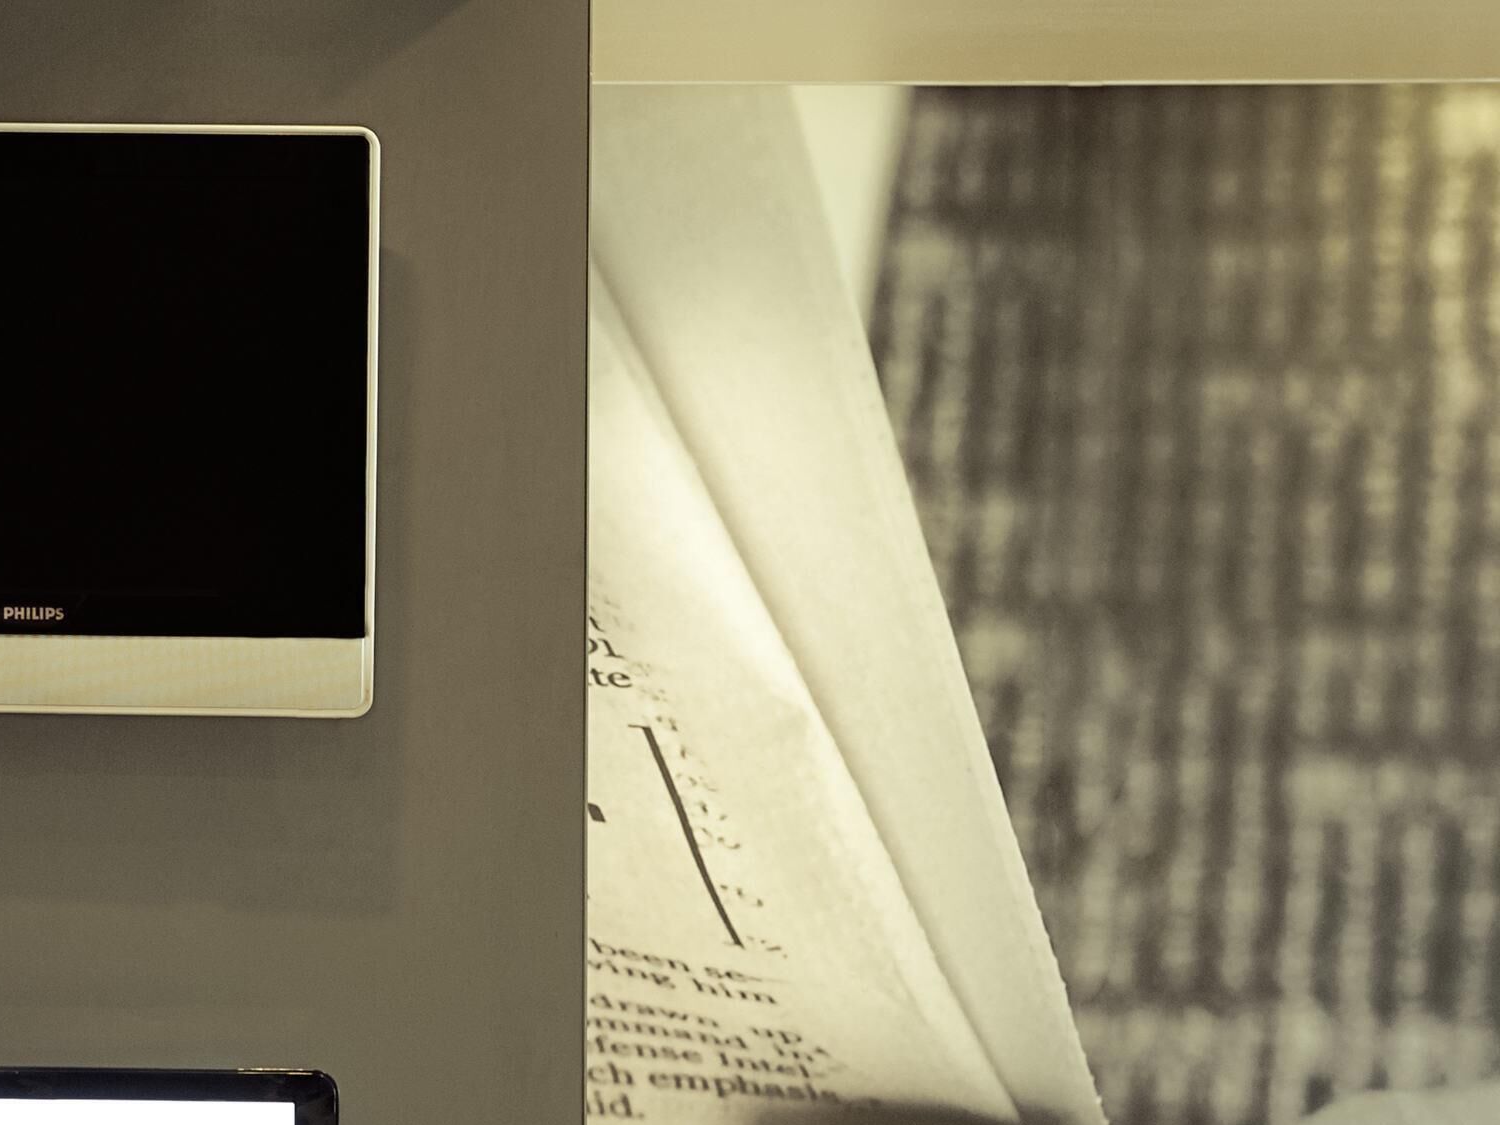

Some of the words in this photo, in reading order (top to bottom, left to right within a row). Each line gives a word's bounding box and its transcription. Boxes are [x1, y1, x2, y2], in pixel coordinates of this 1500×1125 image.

[3, 606, 65, 621] PHILIPS
[588, 937, 691, 973] been
[588, 1033, 705, 1065] fense
